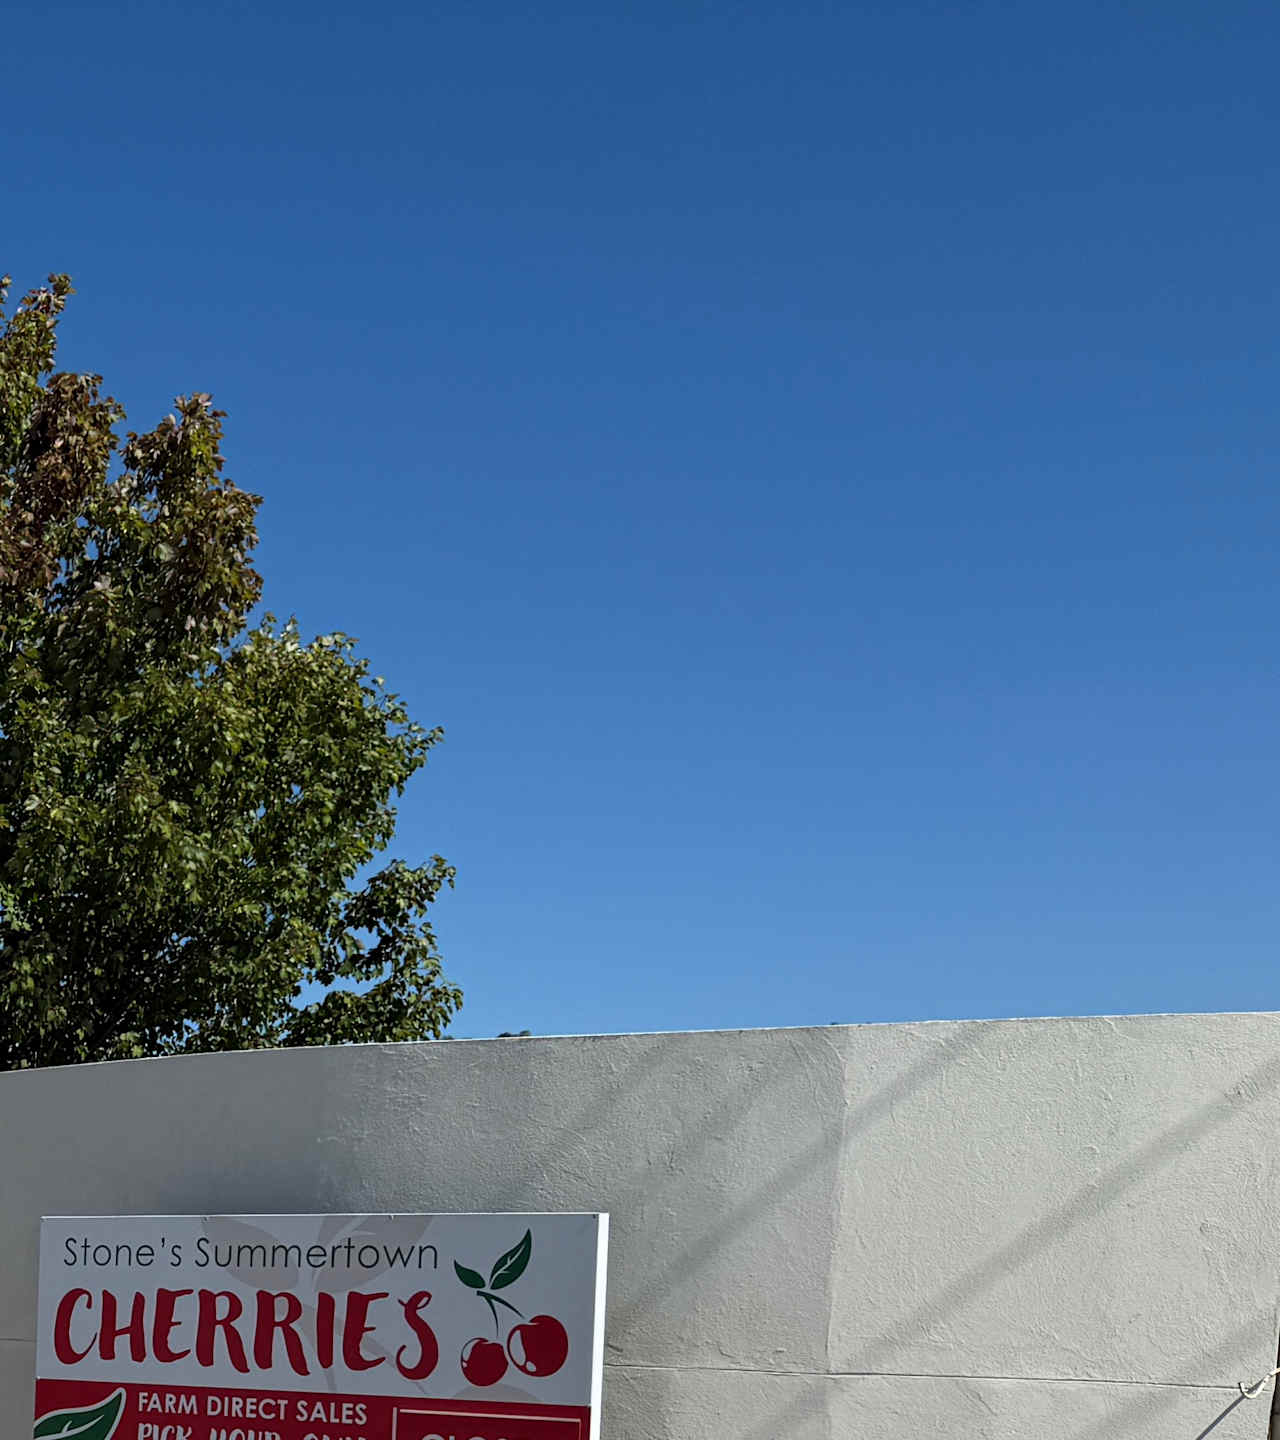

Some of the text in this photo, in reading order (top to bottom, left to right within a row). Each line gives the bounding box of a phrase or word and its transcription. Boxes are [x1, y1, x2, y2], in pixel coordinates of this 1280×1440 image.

[63, 1237, 438, 1269] Stone's Summertown
[53, 1288, 440, 1381] CHERRIES
[138, 1392, 368, 1425] FARM DIRECT SALES
